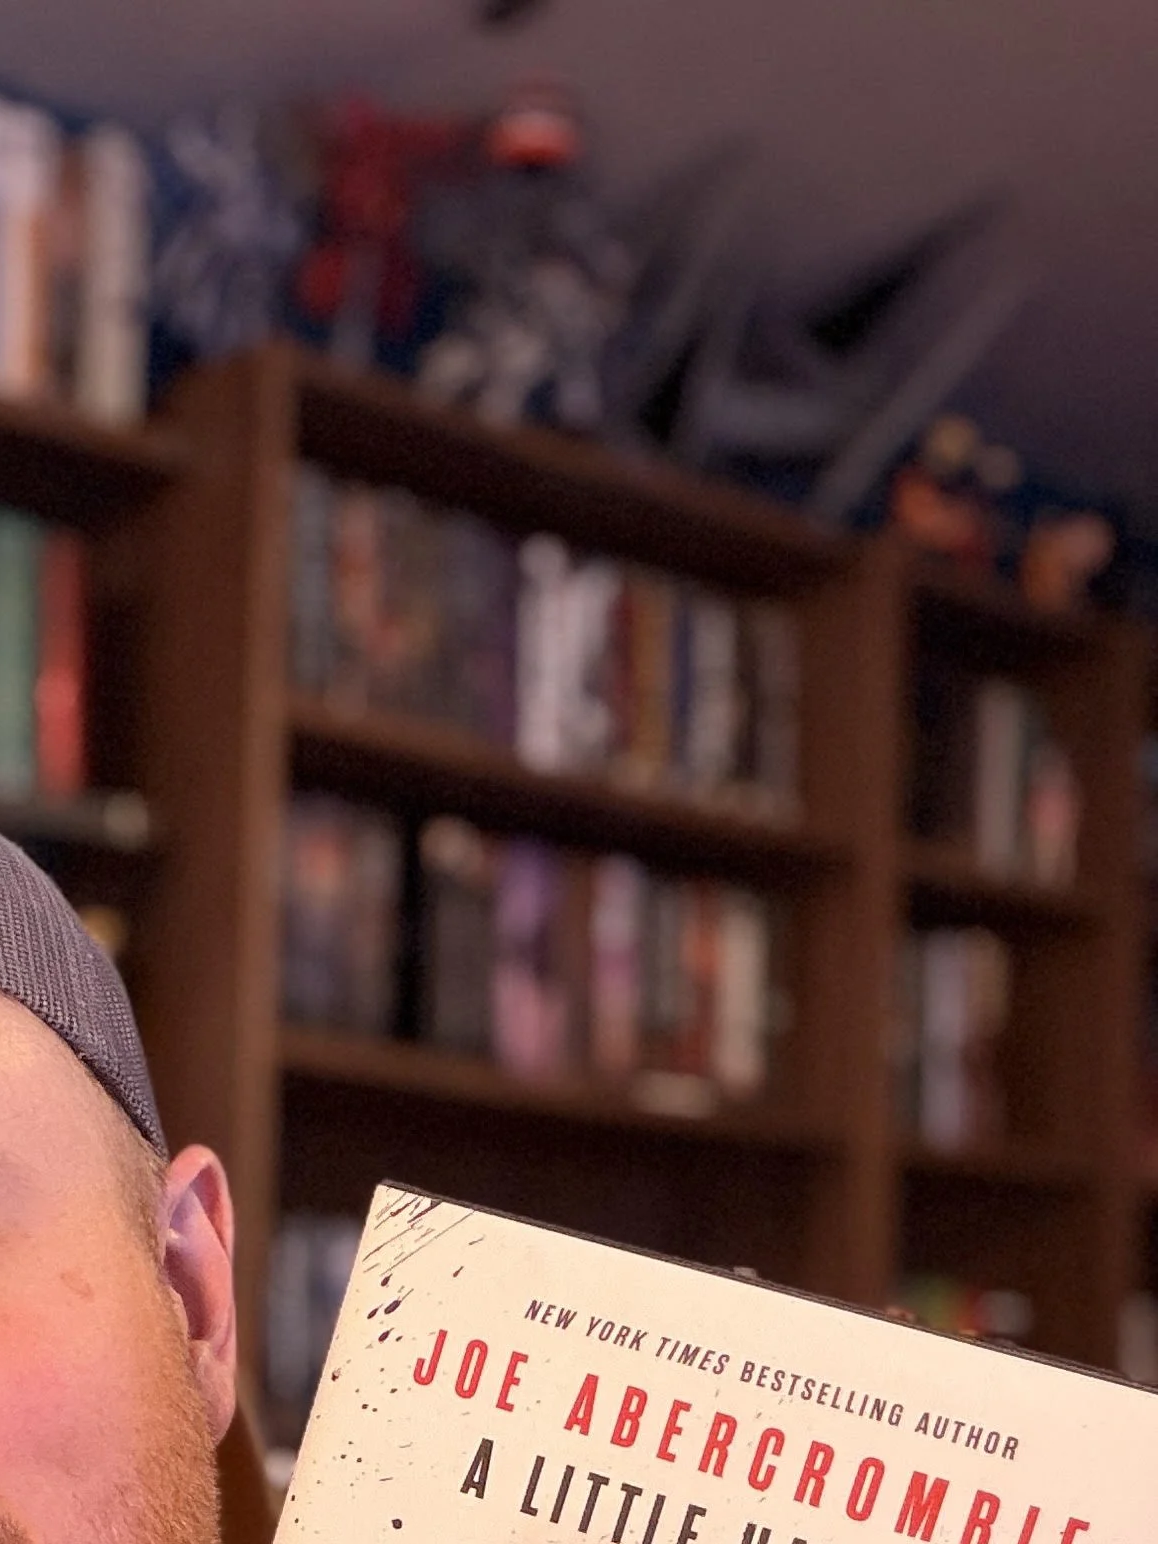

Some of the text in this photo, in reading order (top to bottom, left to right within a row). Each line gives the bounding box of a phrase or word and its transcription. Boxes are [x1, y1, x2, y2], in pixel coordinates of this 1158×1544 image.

[413, 1329, 529, 1412] JOE
[524, 1299, 1020, 1461] NEW YORK TIMES BESTSELLING AUTHOR
[460, 1437, 494, 1499] A
